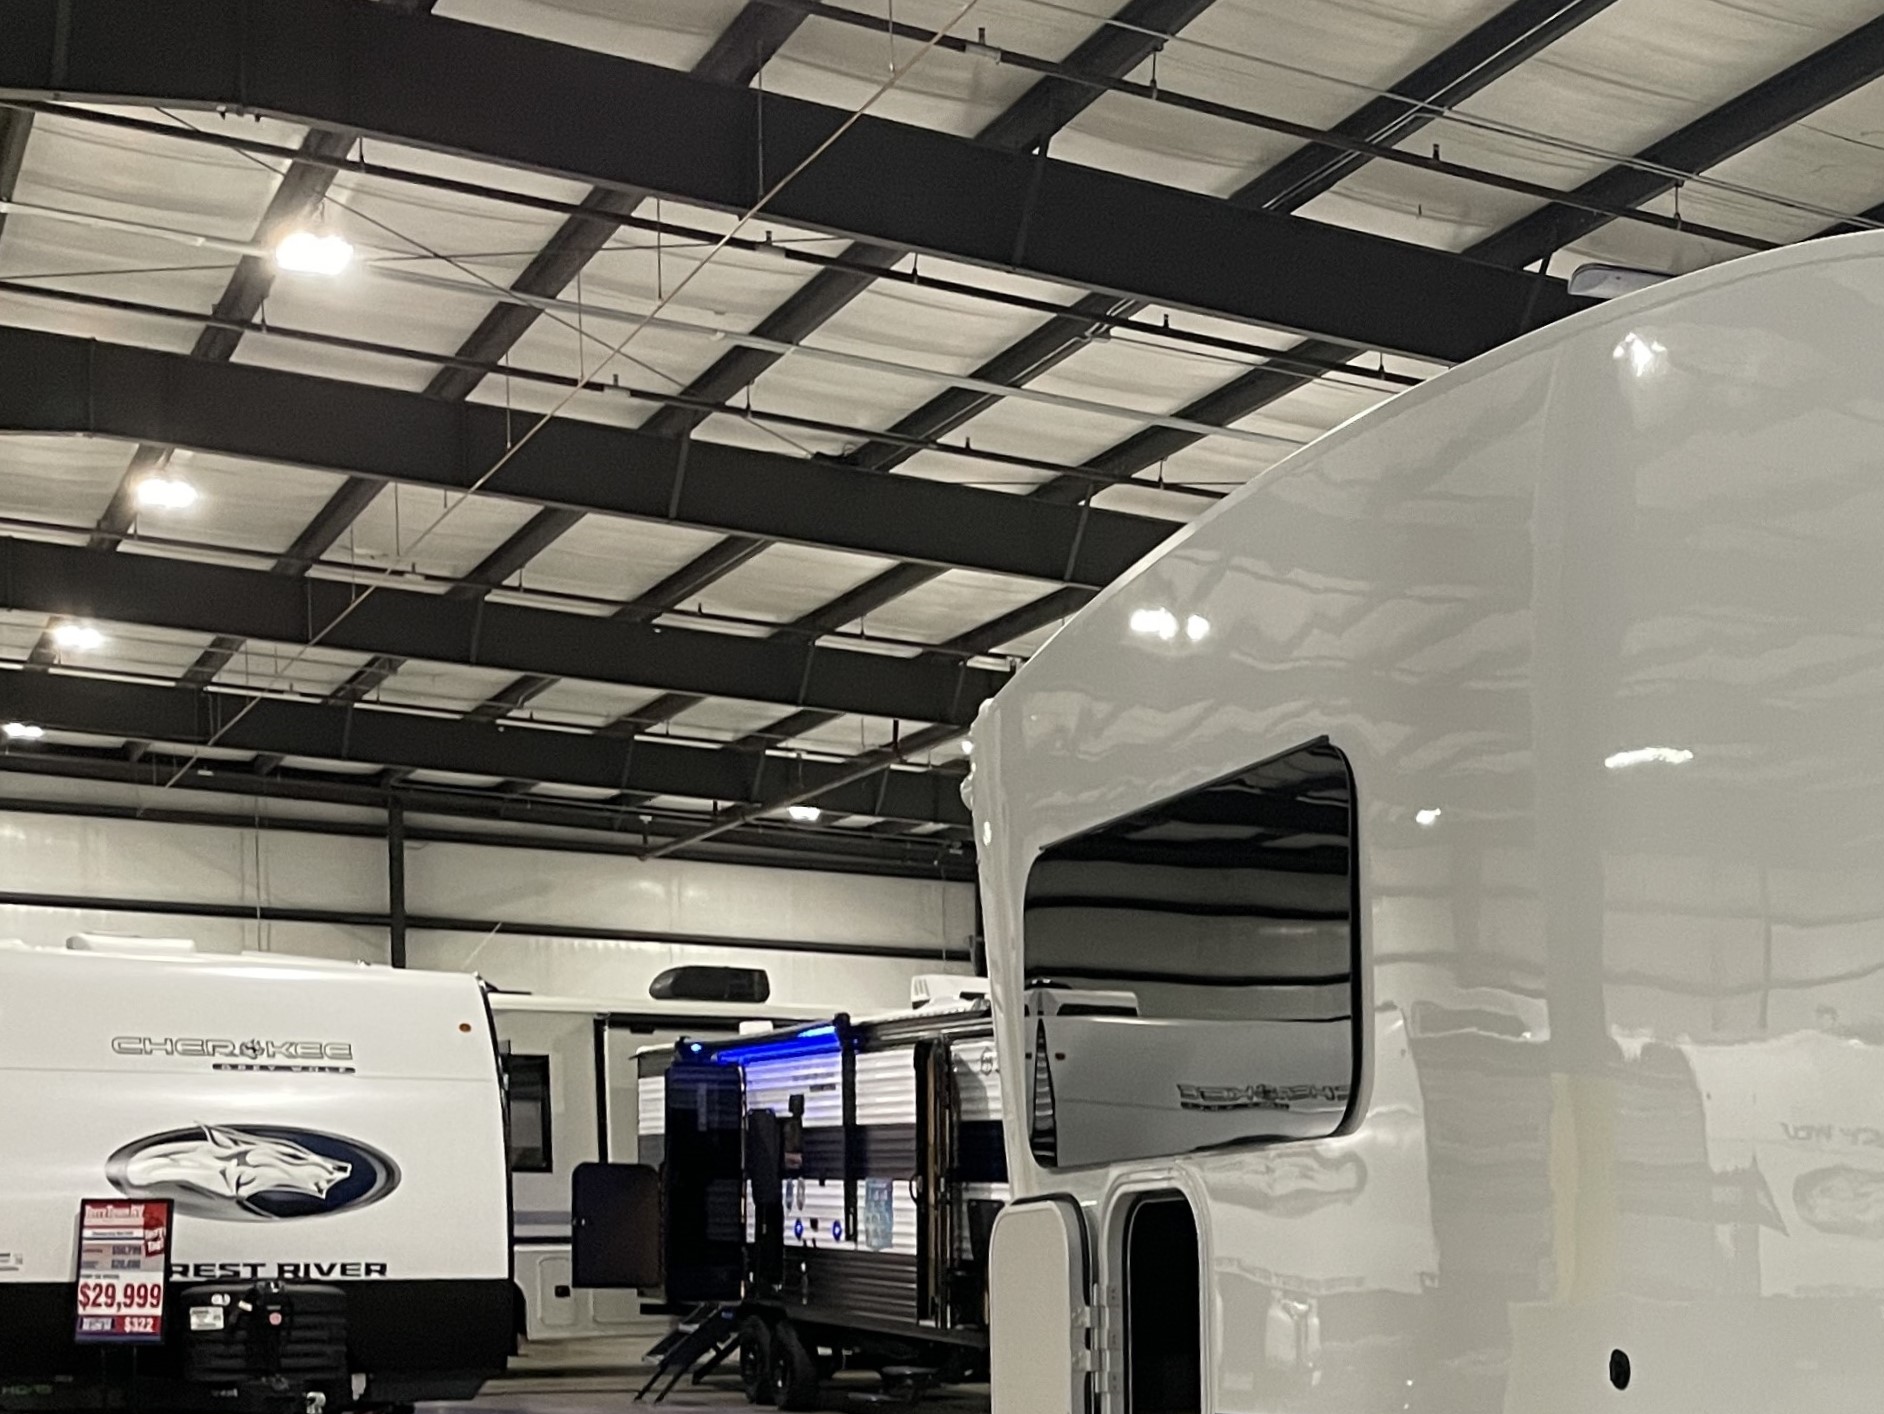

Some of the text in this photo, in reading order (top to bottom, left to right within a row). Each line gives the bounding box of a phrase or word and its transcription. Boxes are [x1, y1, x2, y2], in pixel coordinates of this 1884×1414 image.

[111, 1036, 353, 1060] CHEROKEE
[171, 1262, 388, 1279] REST RIVER
[79, 1283, 161, 1312] $29,999
